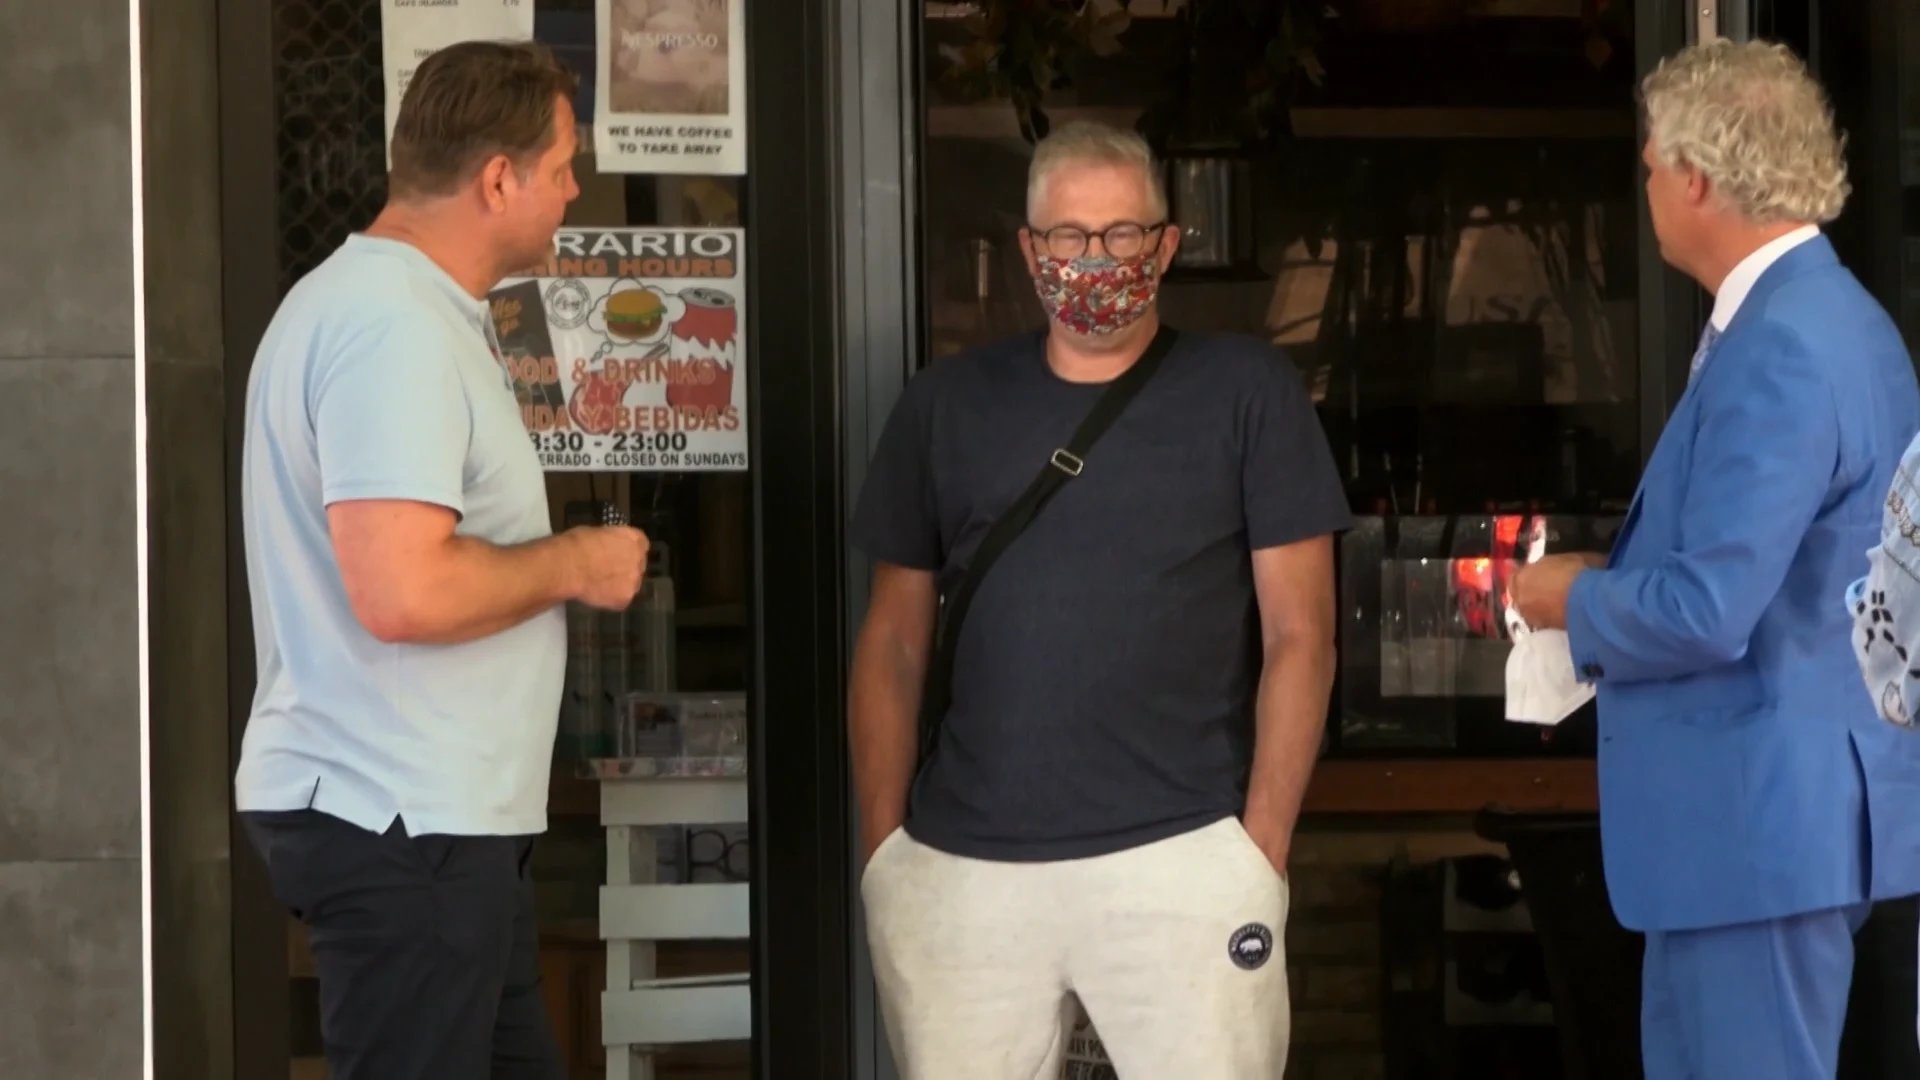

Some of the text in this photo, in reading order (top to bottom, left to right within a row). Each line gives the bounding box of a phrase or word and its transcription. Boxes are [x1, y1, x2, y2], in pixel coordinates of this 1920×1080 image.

[620, 28, 718, 48] NESPRESSO
[608, 126, 733, 139] WE HAVE COFFEE
[618, 143, 723, 156] TO TAKE AWAY
[554, 232, 732, 257] RARIO
[618, 257, 735, 277] HOURS
[571, 358, 592, 385] &
[603, 358, 717, 386] DRINKS
[522, 404, 741, 433] IDA Y BEBIDAS
[612, 431, 688, 452] 23:00
[538, 453, 592, 467] ERRADO
[604, 453, 656, 467] CLOSED
[660, 453, 680, 467] ON
[683, 453, 747, 467] SUNDAYS
